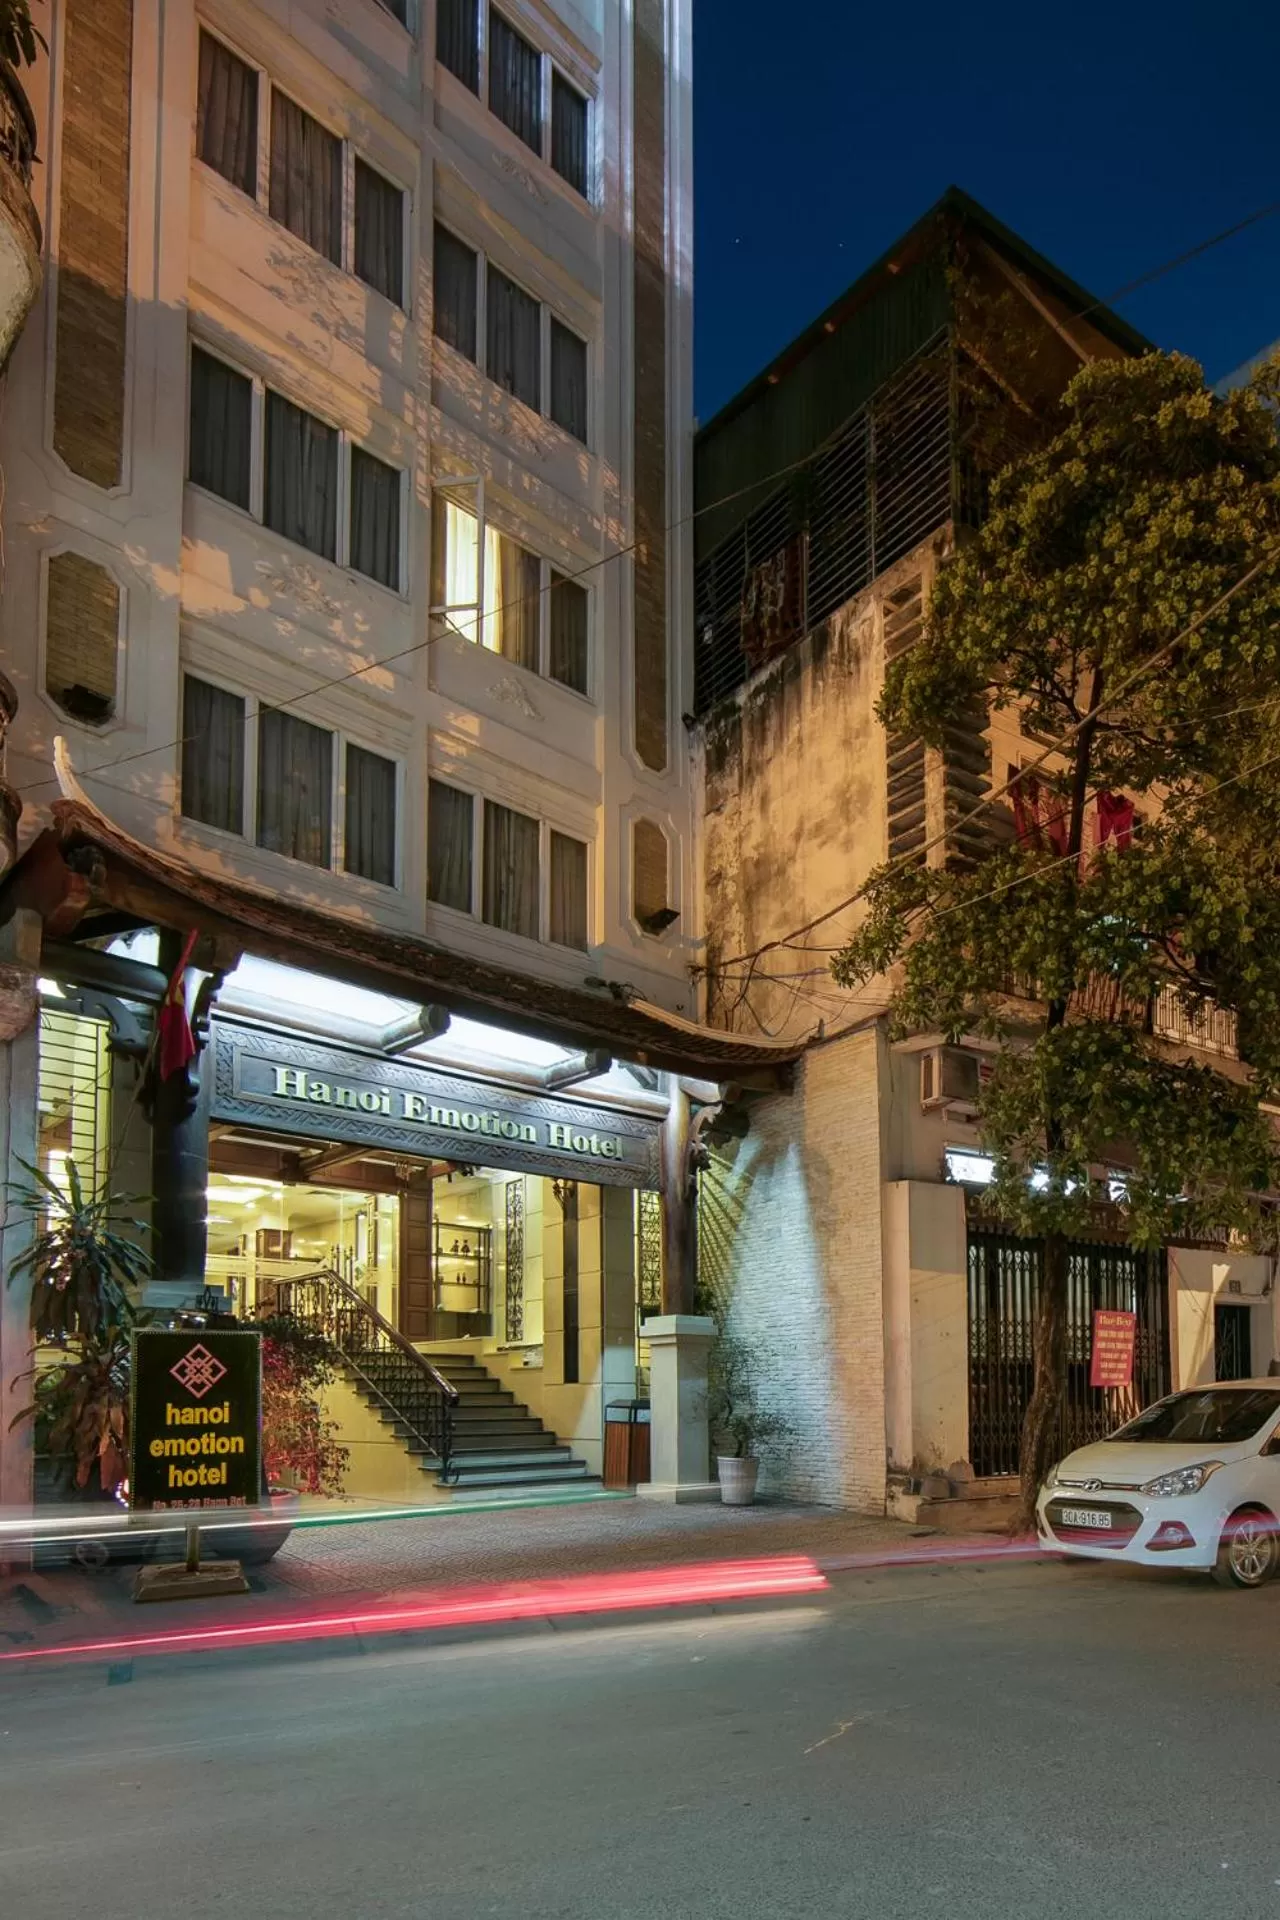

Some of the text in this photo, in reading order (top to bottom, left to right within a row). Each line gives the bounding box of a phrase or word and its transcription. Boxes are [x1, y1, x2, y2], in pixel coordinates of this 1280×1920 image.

[272, 1066, 624, 1161] Hanoi Emotion Hotel
[166, 1402, 230, 1425] hanoi
[150, 1432, 244, 1457] emotion
[169, 1462, 227, 1487] hotel
